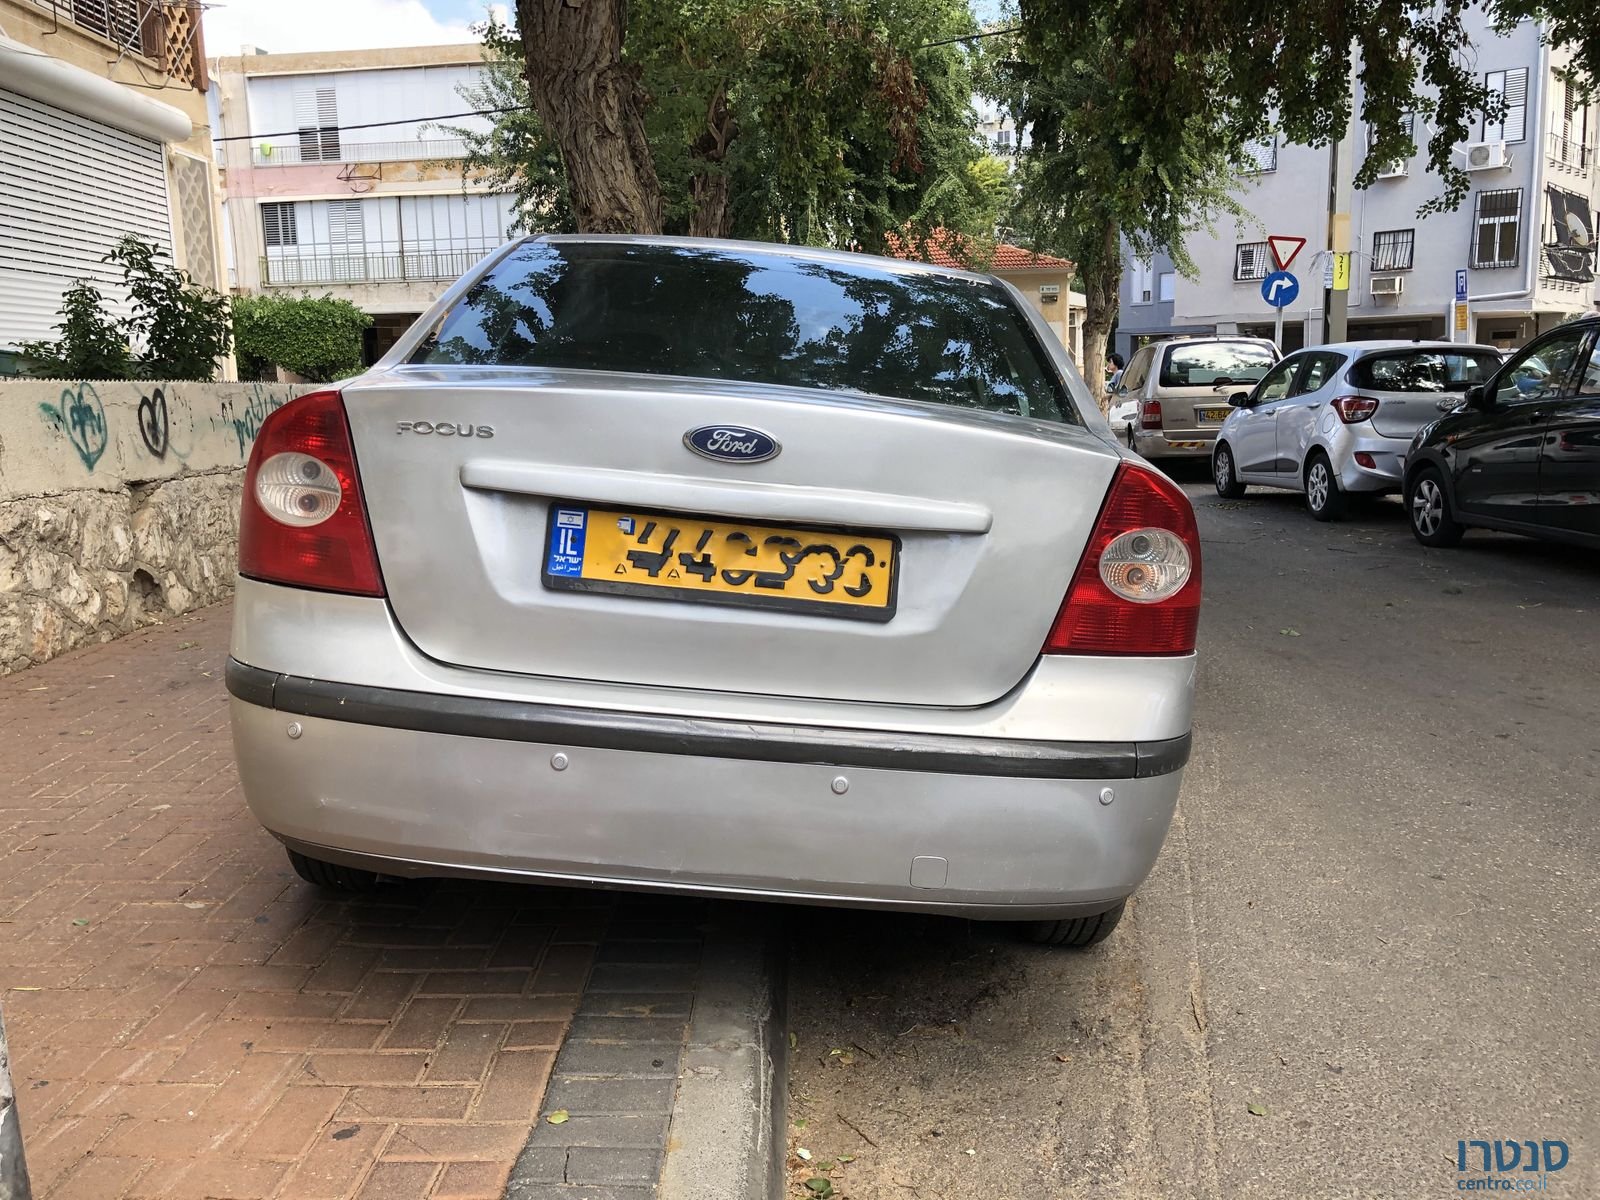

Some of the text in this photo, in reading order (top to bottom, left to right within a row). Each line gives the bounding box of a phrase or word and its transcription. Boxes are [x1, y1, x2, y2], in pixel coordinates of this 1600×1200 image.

[396, 420, 495, 439] FOCUS
[707, 429, 759, 454] Ford
[559, 528, 578, 555] IL
[553, 554, 582, 564] ישראל
